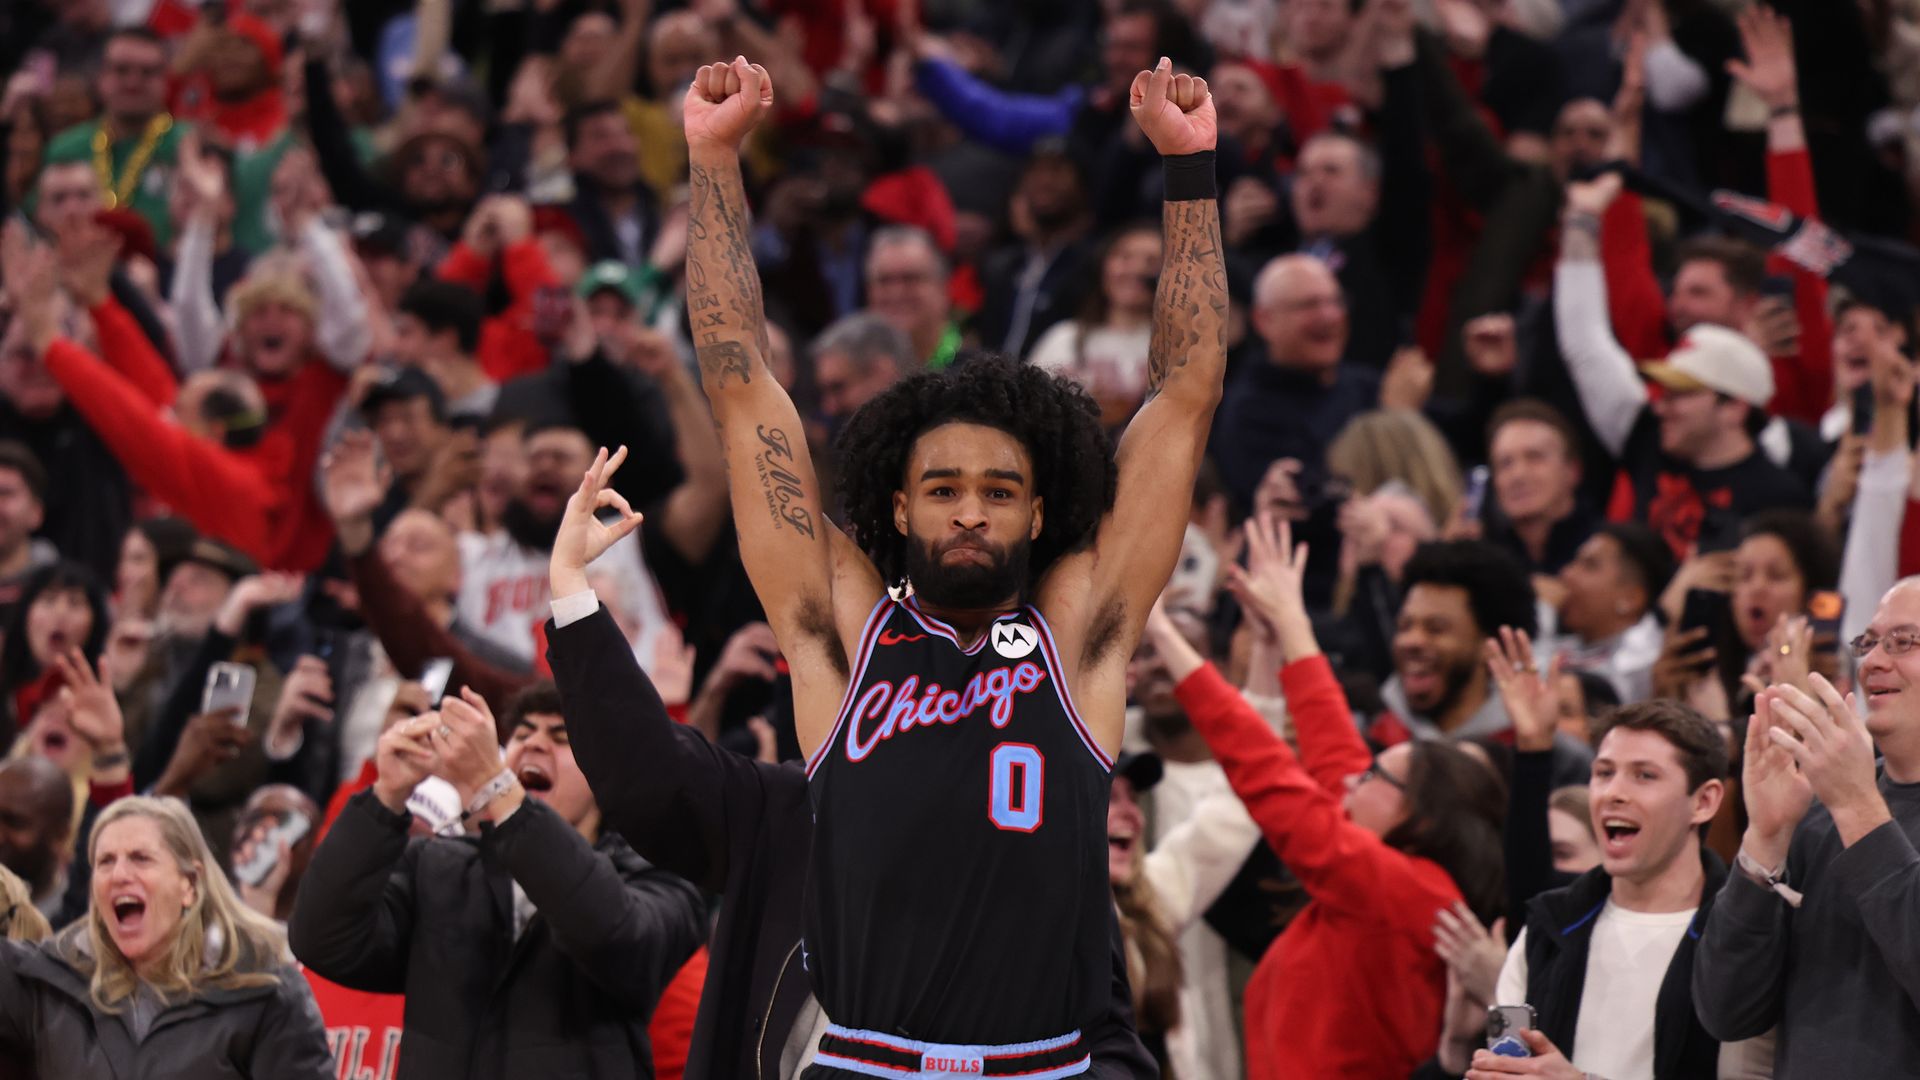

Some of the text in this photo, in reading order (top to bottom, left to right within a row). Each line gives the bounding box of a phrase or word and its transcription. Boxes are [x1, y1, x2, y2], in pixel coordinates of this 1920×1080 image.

[846, 661, 1047, 763] Chicago
[988, 741, 1045, 833] 0
[925, 1056, 980, 1073] BULLS
